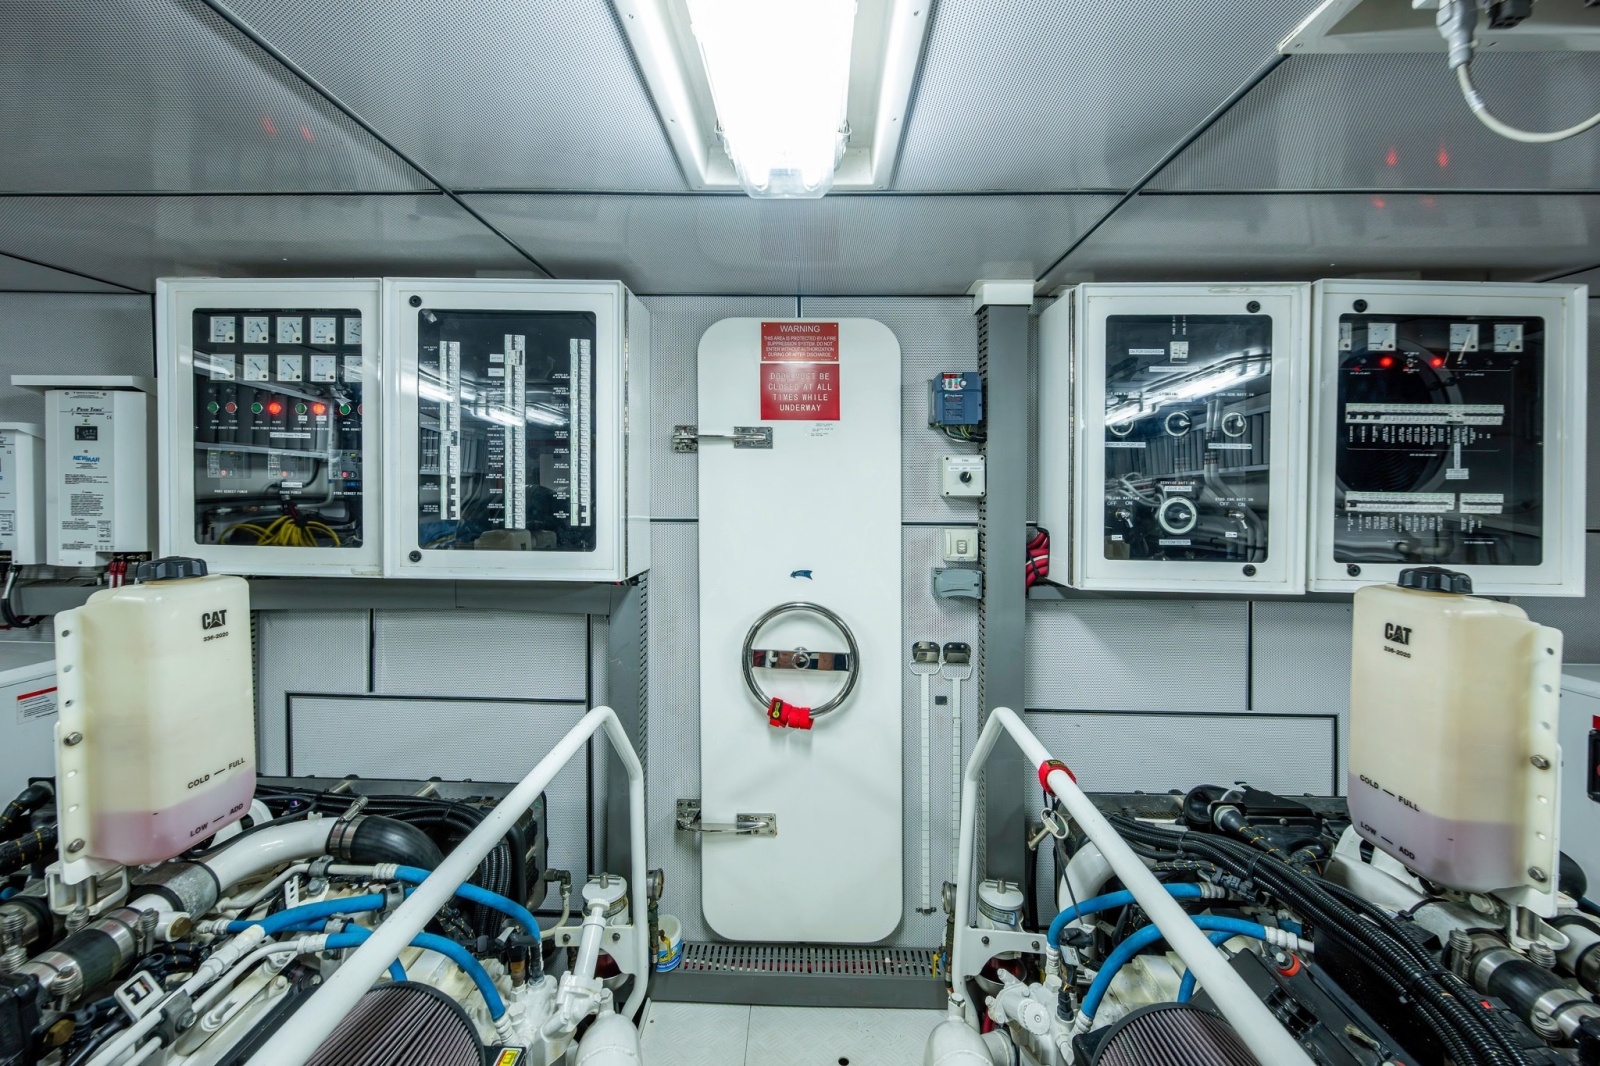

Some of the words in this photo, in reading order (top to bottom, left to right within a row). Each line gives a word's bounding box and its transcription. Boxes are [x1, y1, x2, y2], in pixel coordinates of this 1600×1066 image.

[202, 609, 227, 630] CAT
[1384, 622, 1412, 645] CAT
[187, 774, 210, 789] COLD
[228, 757, 245, 770] FULL
[1360, 774, 1379, 789] COLD
[1398, 796, 1420, 812] FULL
[190, 822, 208, 837] LOW
[229, 803, 244, 815] ADD
[1360, 821, 1376, 835] LOW
[1399, 846, 1415, 860] ADD
